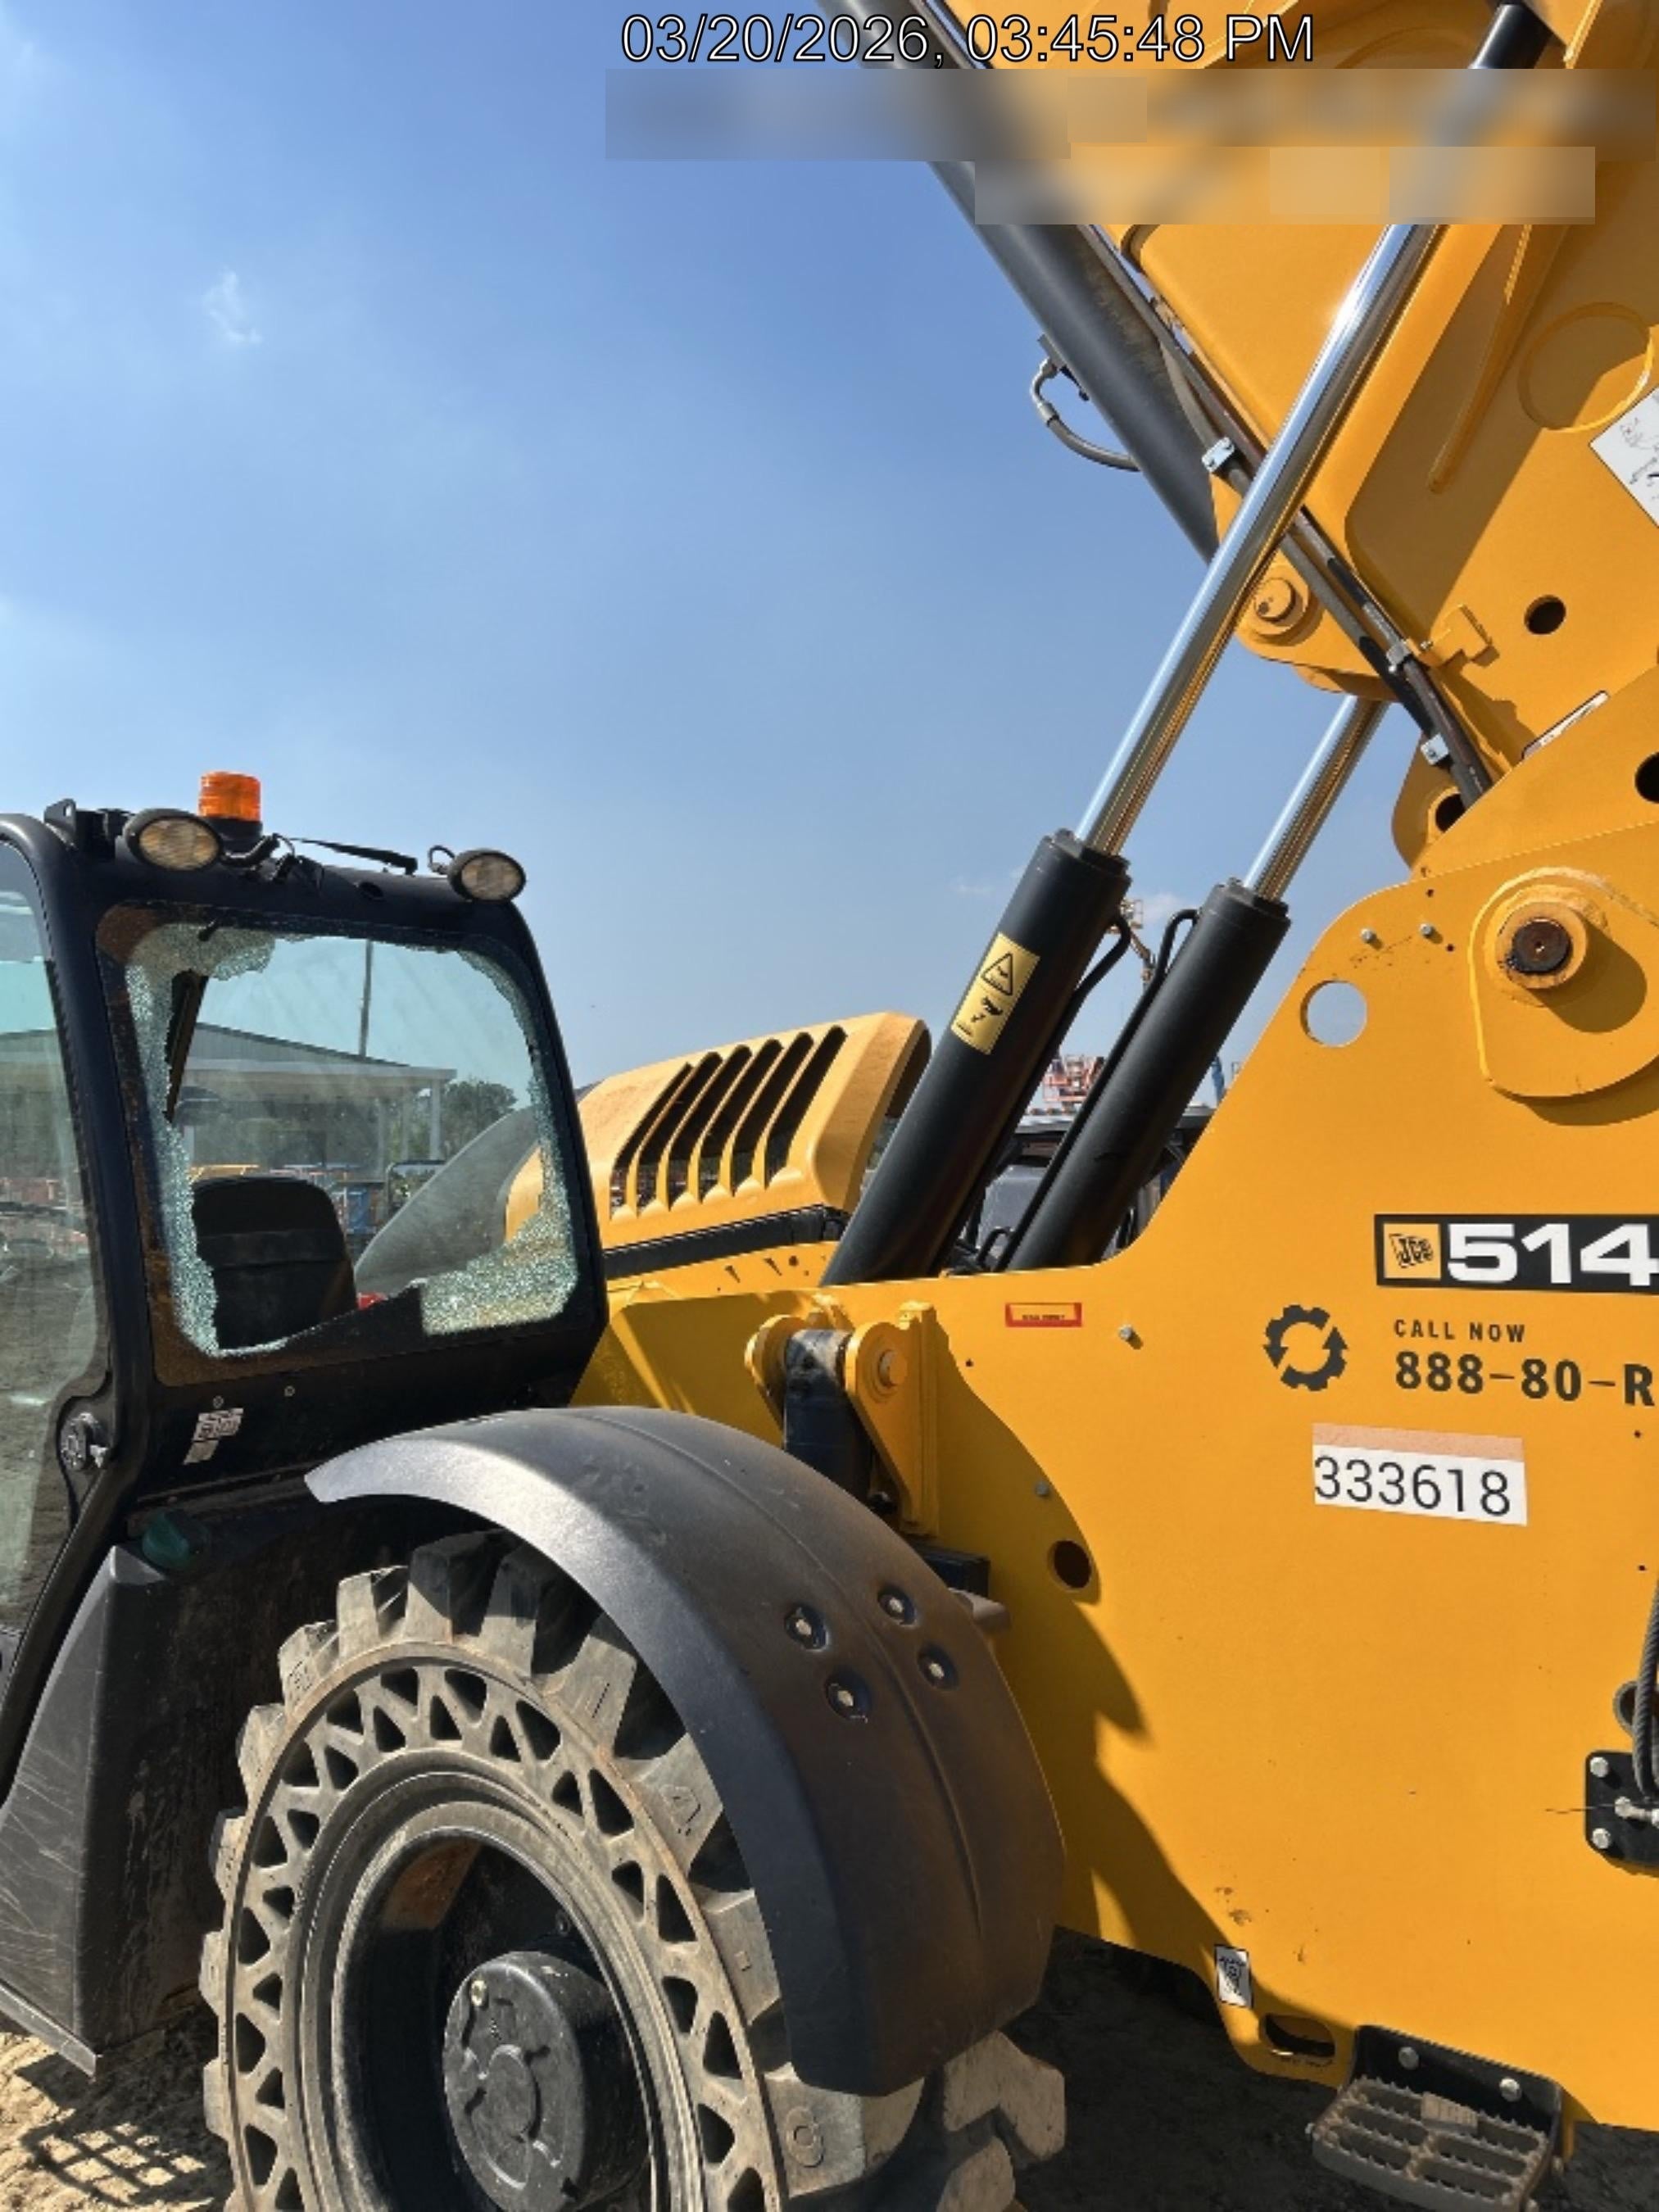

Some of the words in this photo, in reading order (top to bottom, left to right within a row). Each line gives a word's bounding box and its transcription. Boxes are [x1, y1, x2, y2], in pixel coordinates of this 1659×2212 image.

[1394, 1319, 1455, 1339] CALL
[1469, 1323, 1525, 1343] NOW
[1395, 1350, 1655, 1407] 888-80-R
[1314, 1455, 1510, 1516] 333618
